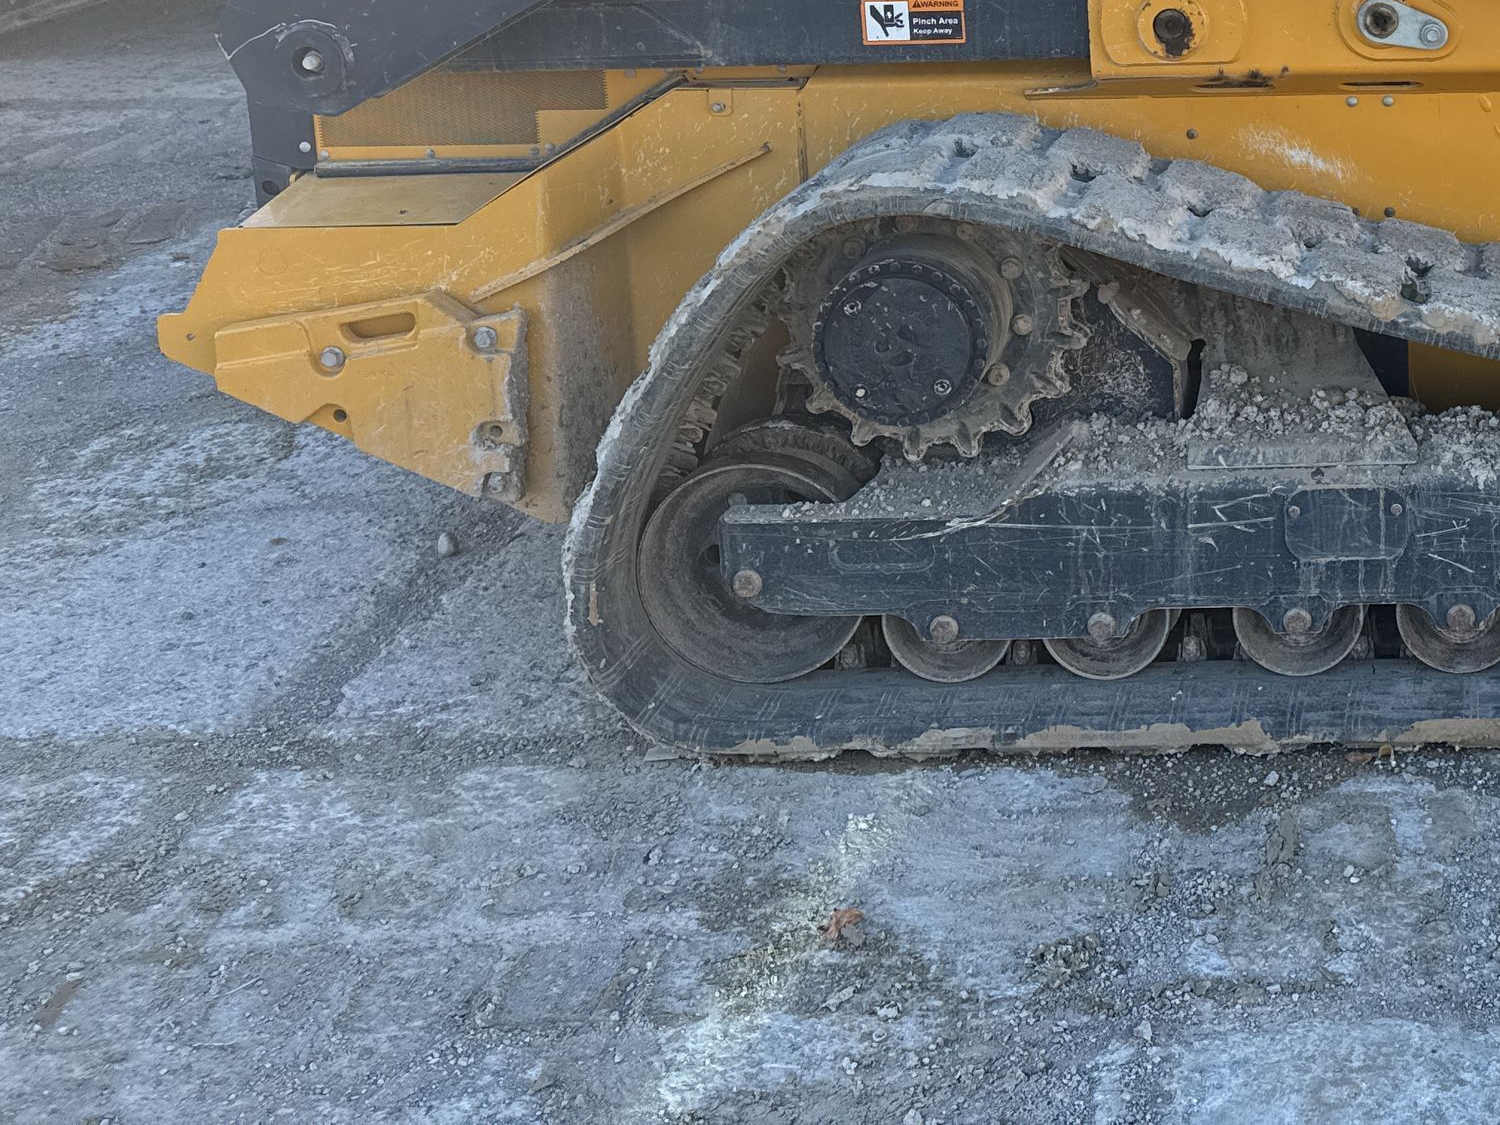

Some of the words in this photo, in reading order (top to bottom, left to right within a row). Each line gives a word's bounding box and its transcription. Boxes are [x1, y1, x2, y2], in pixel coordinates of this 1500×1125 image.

[920, 0, 959, 8] WARNING
[912, 17, 936, 25] Pinch
[938, 17, 959, 25] Area
[913, 28, 932, 36] Keep
[933, 27, 952, 35] Away
